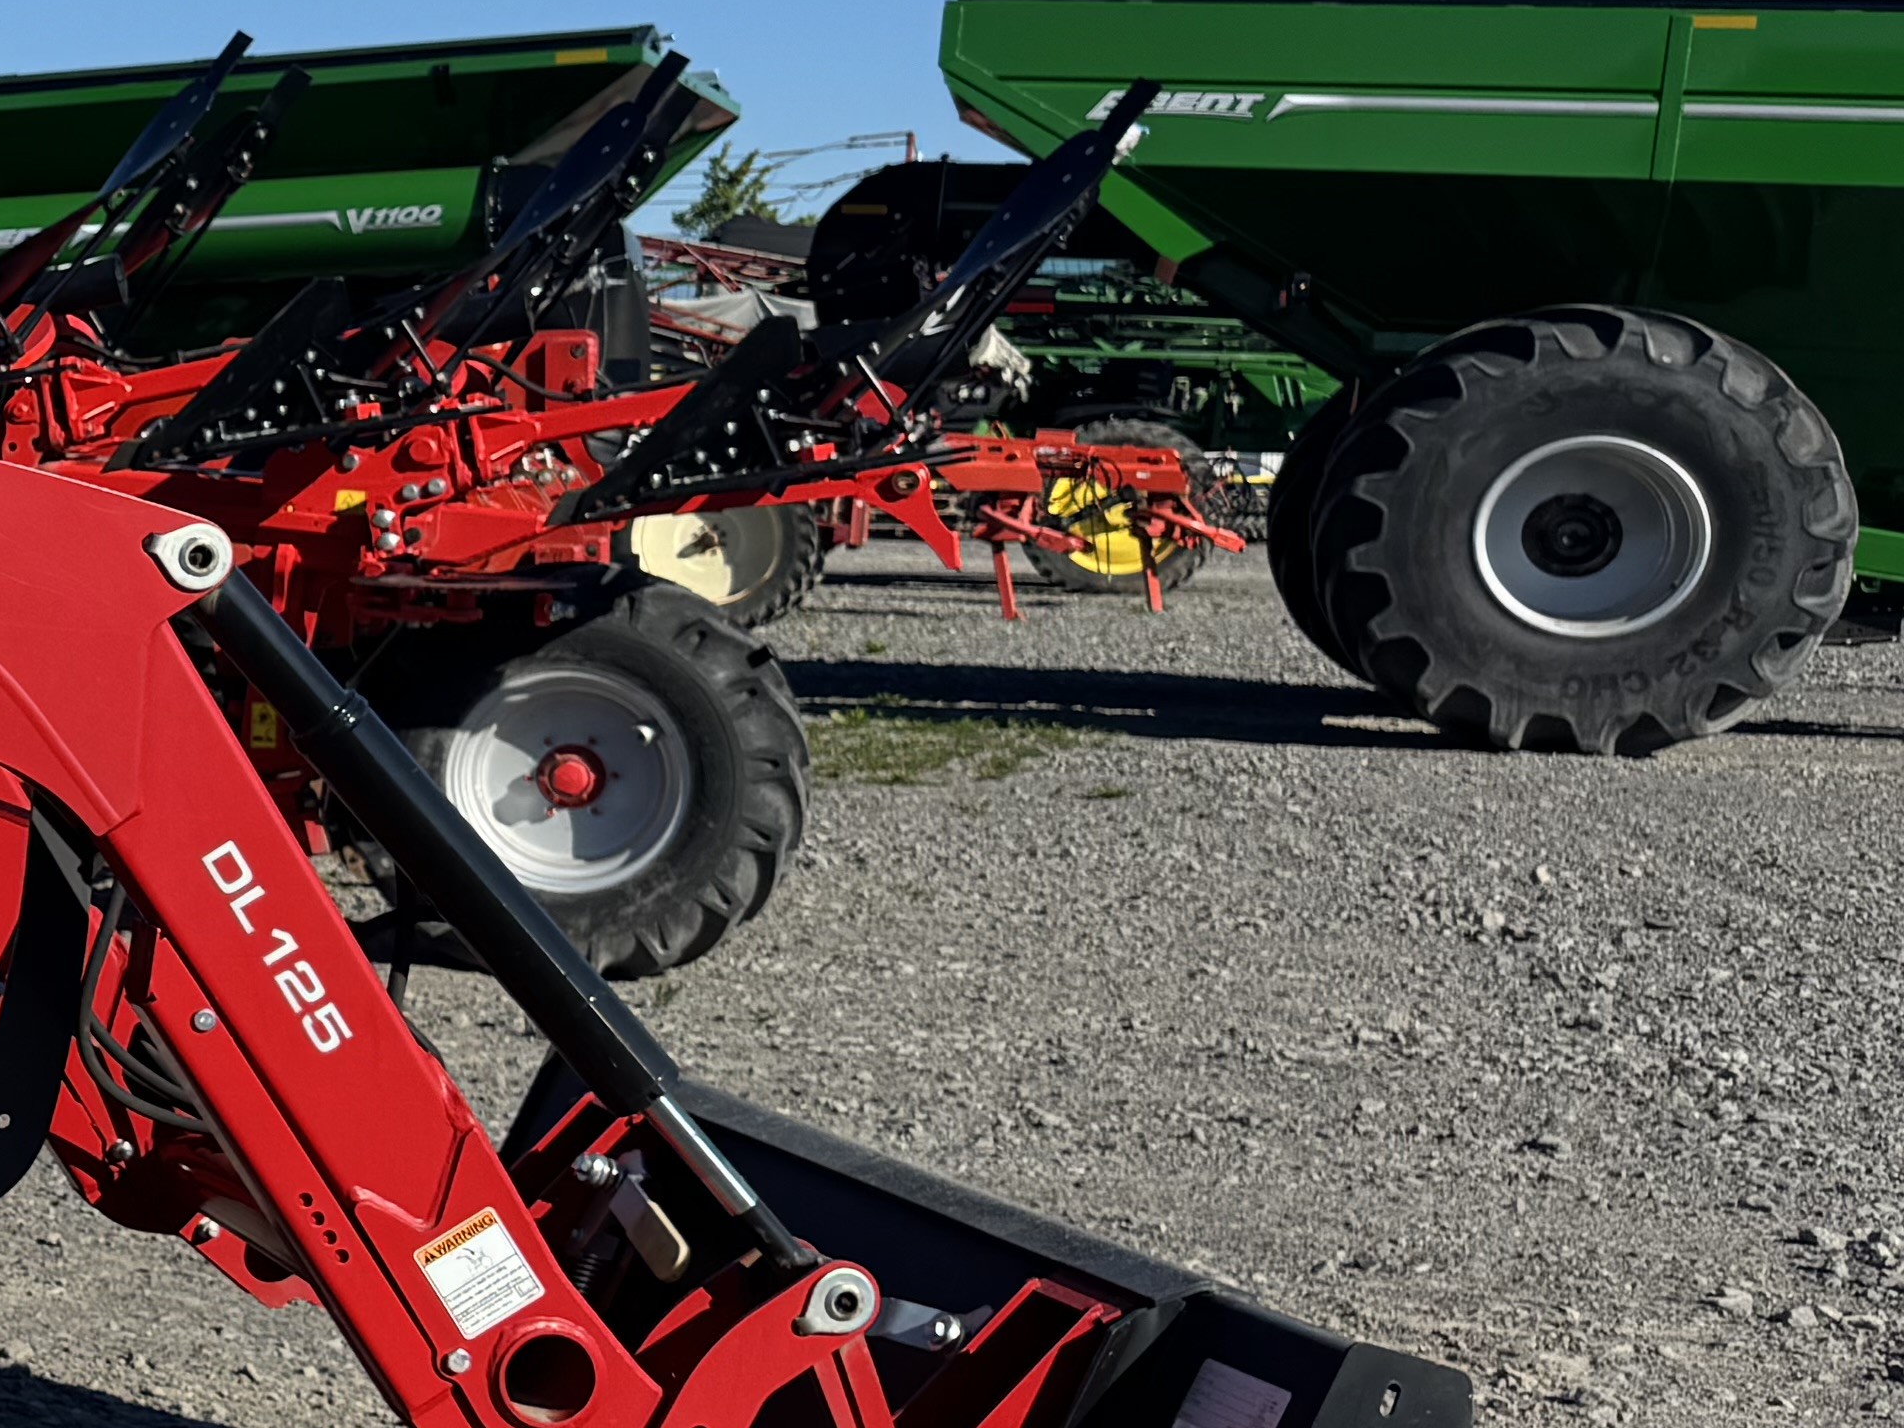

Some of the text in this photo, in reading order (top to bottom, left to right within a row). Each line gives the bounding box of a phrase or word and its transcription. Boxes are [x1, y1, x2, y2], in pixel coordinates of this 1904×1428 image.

[345, 204, 443, 234] V1100
[201, 839, 354, 1054] DL 125
[433, 1213, 494, 1257] WARNING
